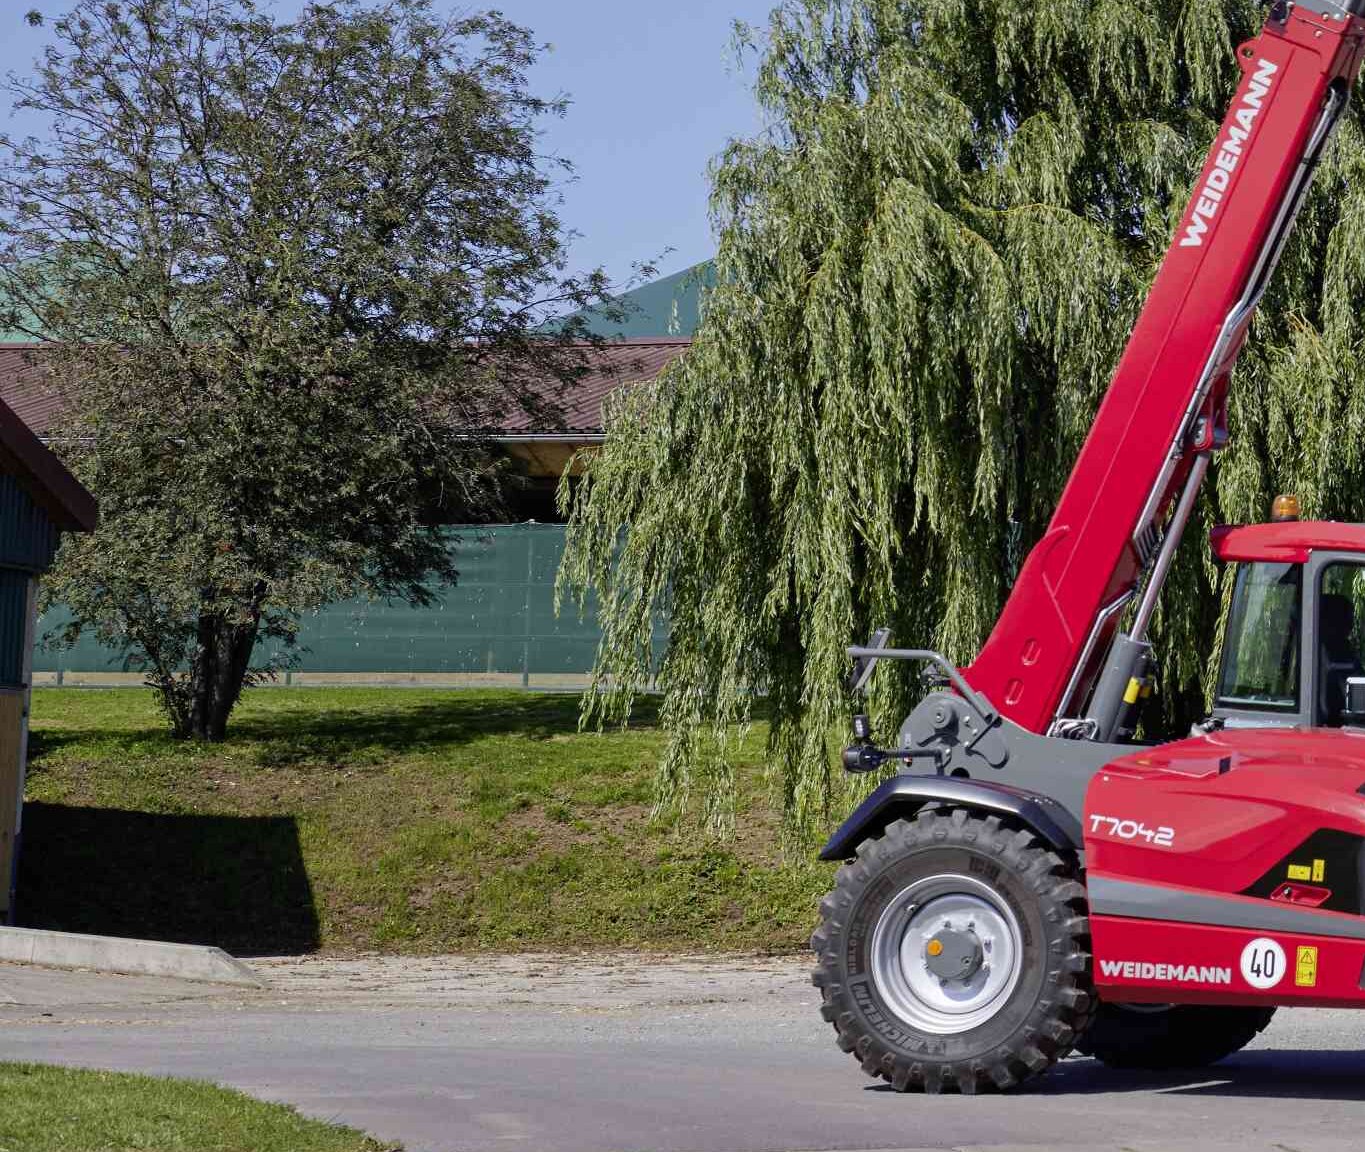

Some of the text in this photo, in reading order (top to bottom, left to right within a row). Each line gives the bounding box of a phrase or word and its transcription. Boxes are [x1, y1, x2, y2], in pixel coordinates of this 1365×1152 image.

[1179, 58, 1279, 247] WEIDEMANN
[1090, 814, 1175, 846] T7042
[1100, 960, 1231, 984] WEIDEMANN
[1250, 949, 1275, 978] 40
[851, 982, 924, 1051] MICHELIN
